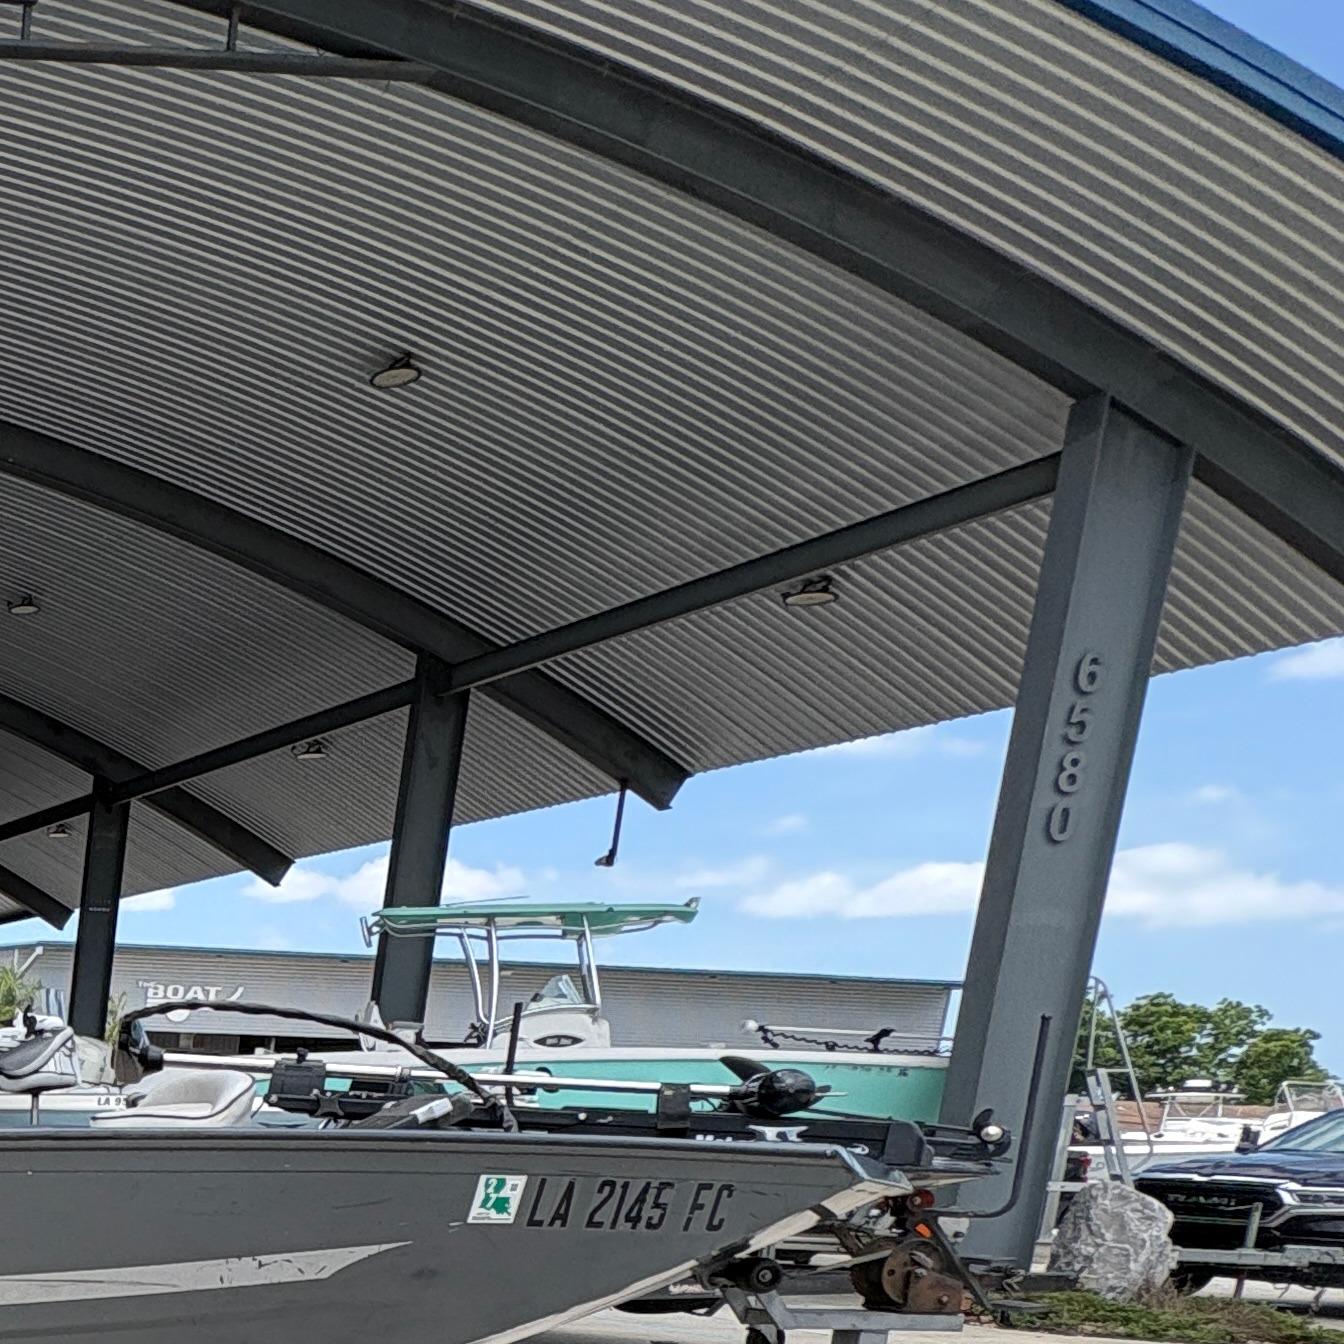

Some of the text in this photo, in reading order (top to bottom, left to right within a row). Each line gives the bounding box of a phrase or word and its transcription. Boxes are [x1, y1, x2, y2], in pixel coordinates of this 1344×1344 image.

[1047, 652, 1105, 842] 6580
[147, 985, 223, 1001] BOAT
[526, 1177, 736, 1233] LA 2145 FC
